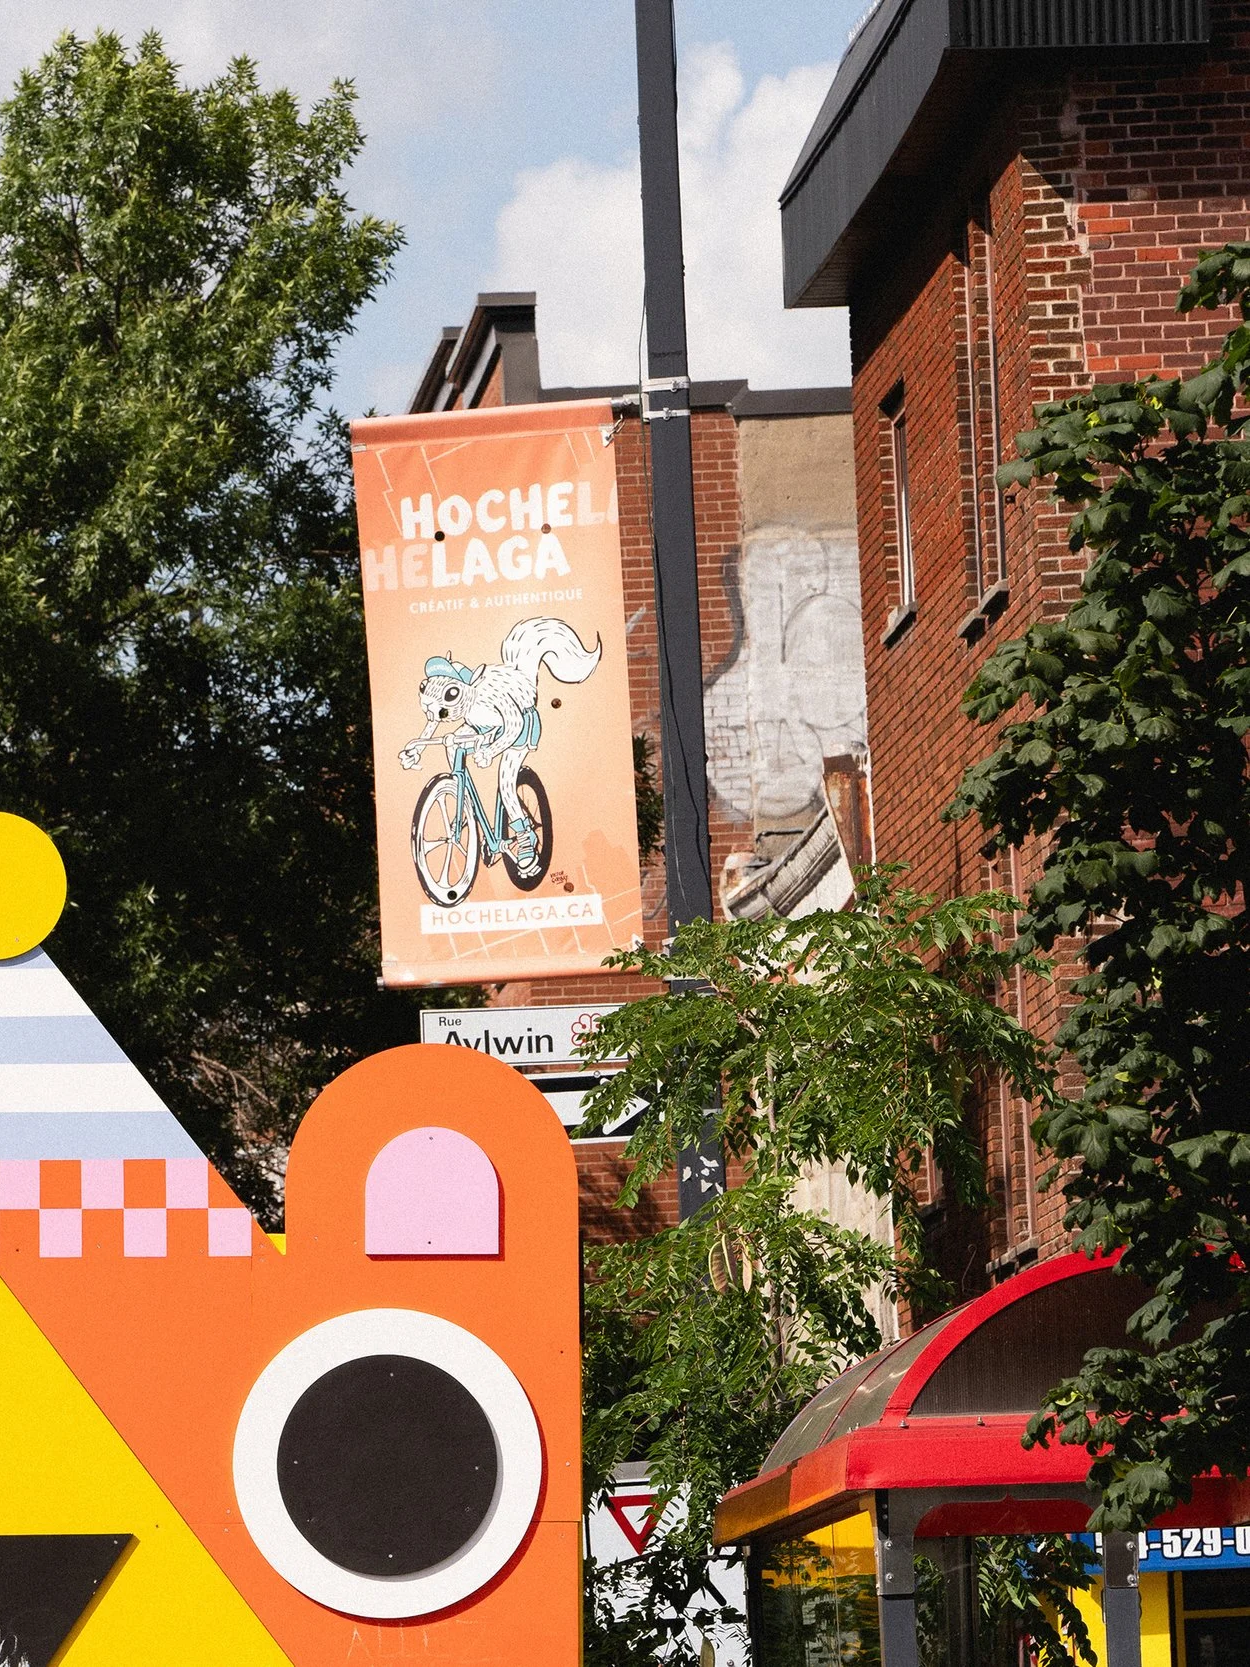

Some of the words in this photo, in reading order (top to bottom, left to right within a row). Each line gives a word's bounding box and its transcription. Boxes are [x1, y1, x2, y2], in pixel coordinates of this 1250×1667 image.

[409, 598, 465, 614] CRÉATIF
[469, 599, 480, 609] &
[484, 588, 584, 608] AUTHENTIQUE
[432, 903, 593, 925] HOCHELAGA.CA
[438, 1015, 462, 1027] Rue
